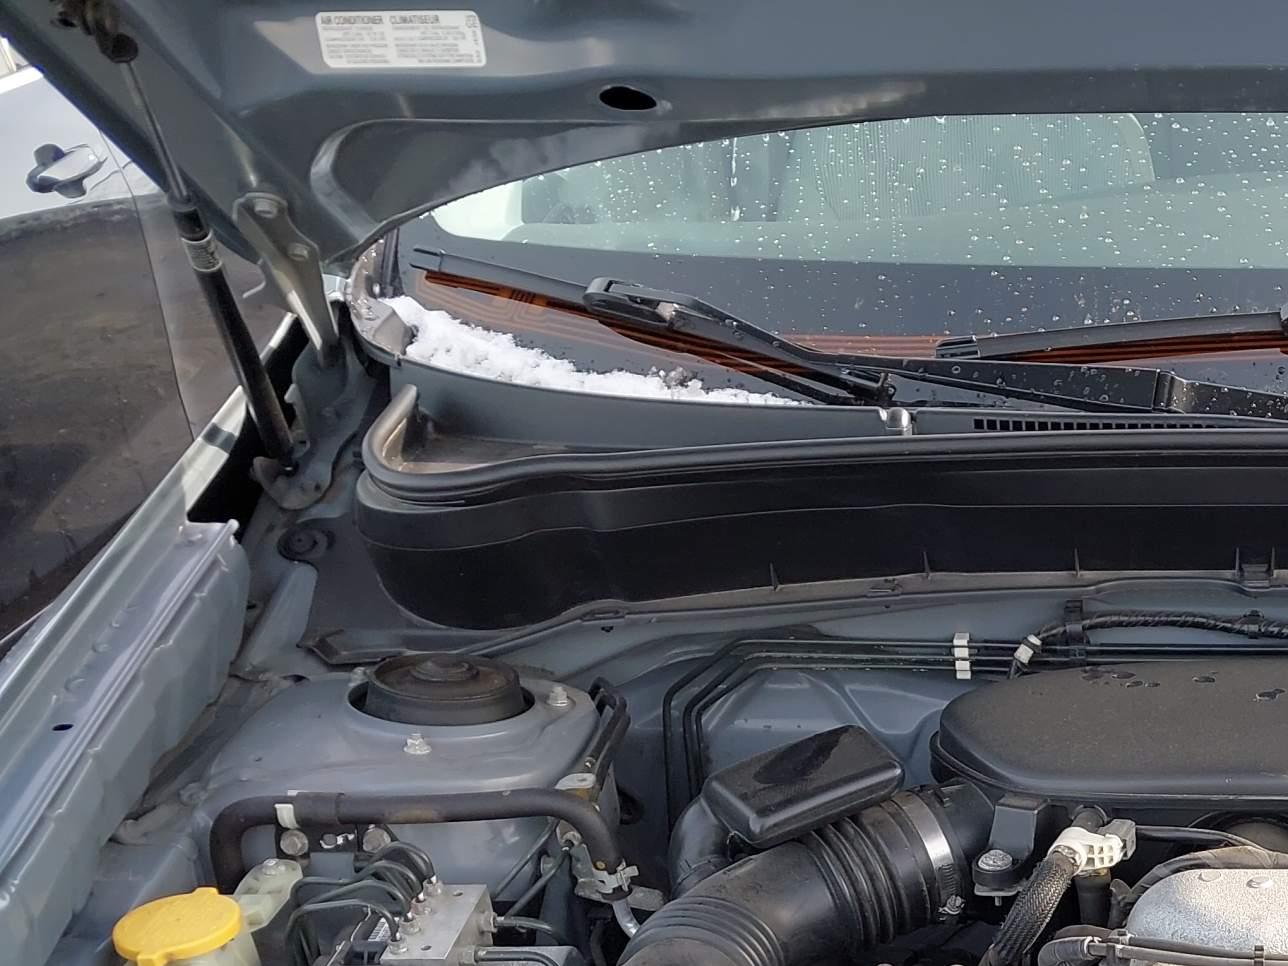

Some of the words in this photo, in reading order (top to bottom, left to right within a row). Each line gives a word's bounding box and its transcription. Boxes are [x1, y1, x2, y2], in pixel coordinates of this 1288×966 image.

[320, 15, 332, 25] AIR
[334, 15, 384, 25] CONDITIONER
[389, 15, 440, 25] CLIMATISEUR
